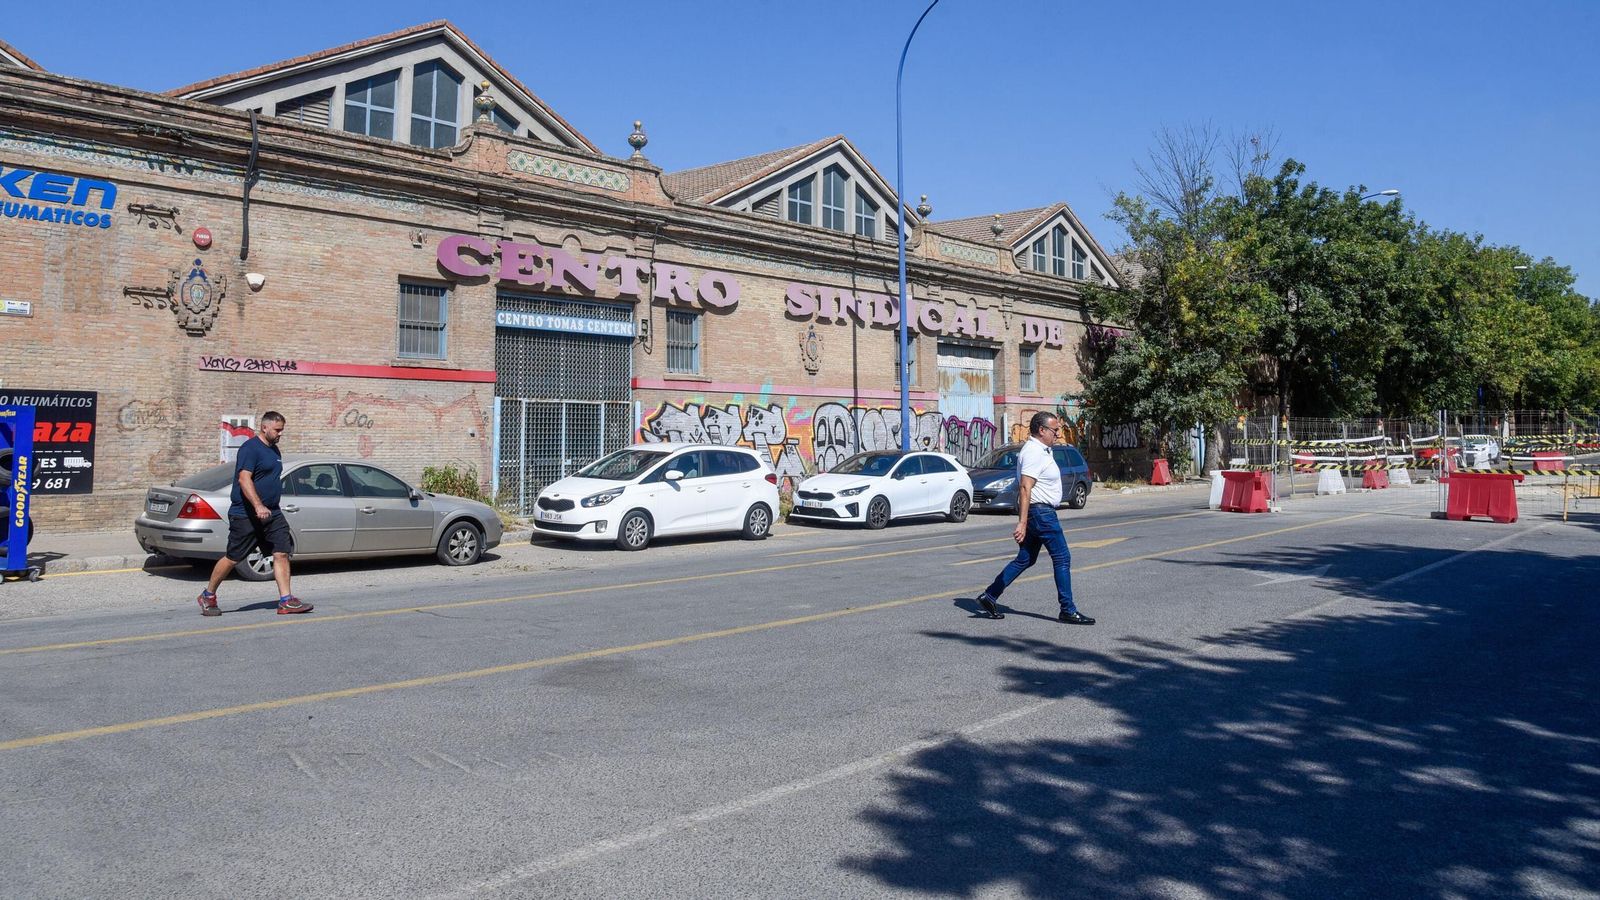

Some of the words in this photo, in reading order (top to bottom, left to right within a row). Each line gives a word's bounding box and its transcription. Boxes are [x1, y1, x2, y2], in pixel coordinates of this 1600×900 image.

[0, 201, 112, 229] UMATICOS
[437, 235, 740, 308] CENTRO
[497, 312, 544, 328] CENTRO
[546, 317, 584, 331] TOMAS
[784, 281, 997, 337] SINDICAL
[1023, 315, 1066, 346] DE
[12, 394, 93, 408] NEUMÁTICOS
[33, 422, 92, 442] aza
[38, 458, 57, 468] ES
[14, 455, 28, 528] GOODYEAR
[44, 478, 71, 489] 681
